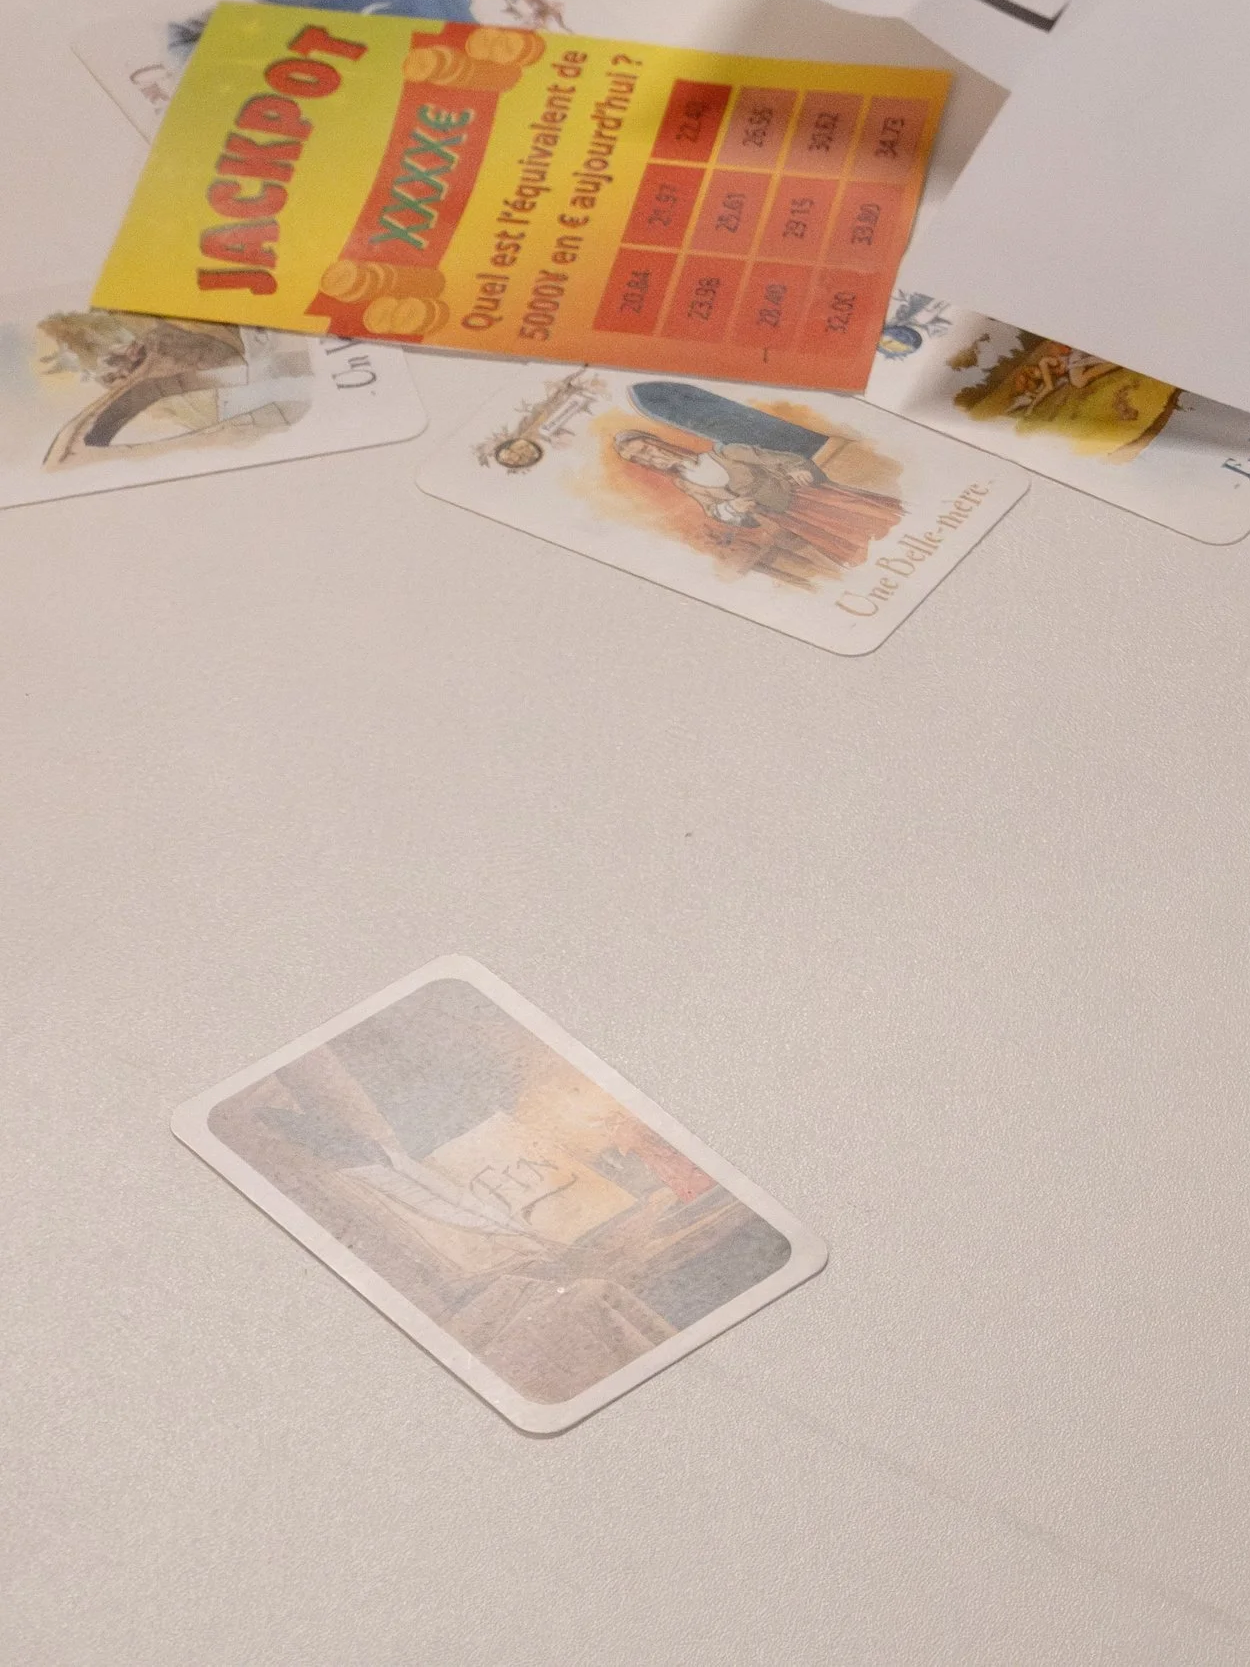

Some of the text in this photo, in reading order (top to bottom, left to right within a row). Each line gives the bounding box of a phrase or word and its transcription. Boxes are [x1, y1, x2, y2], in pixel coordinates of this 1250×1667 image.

[197, 24, 368, 295] JACKPOT
[371, 103, 474, 251] XXXX€
[461, 49, 590, 332] Quel est l'équivalent de
[571, 71, 642, 211] aujourd'hui
[551, 233, 584, 268] en
[557, 211, 591, 231] €
[687, 276, 721, 322] 23.98
[715, 192, 746, 234] 25.61
[824, 290, 857, 335] 32.00
[874, 117, 906, 160] 34.73
[517, 269, 570, 342] 5000¥
[620, 269, 653, 314] 20.84
[330, 354, 378, 390] Un
[834, 574, 900, 617] Une
